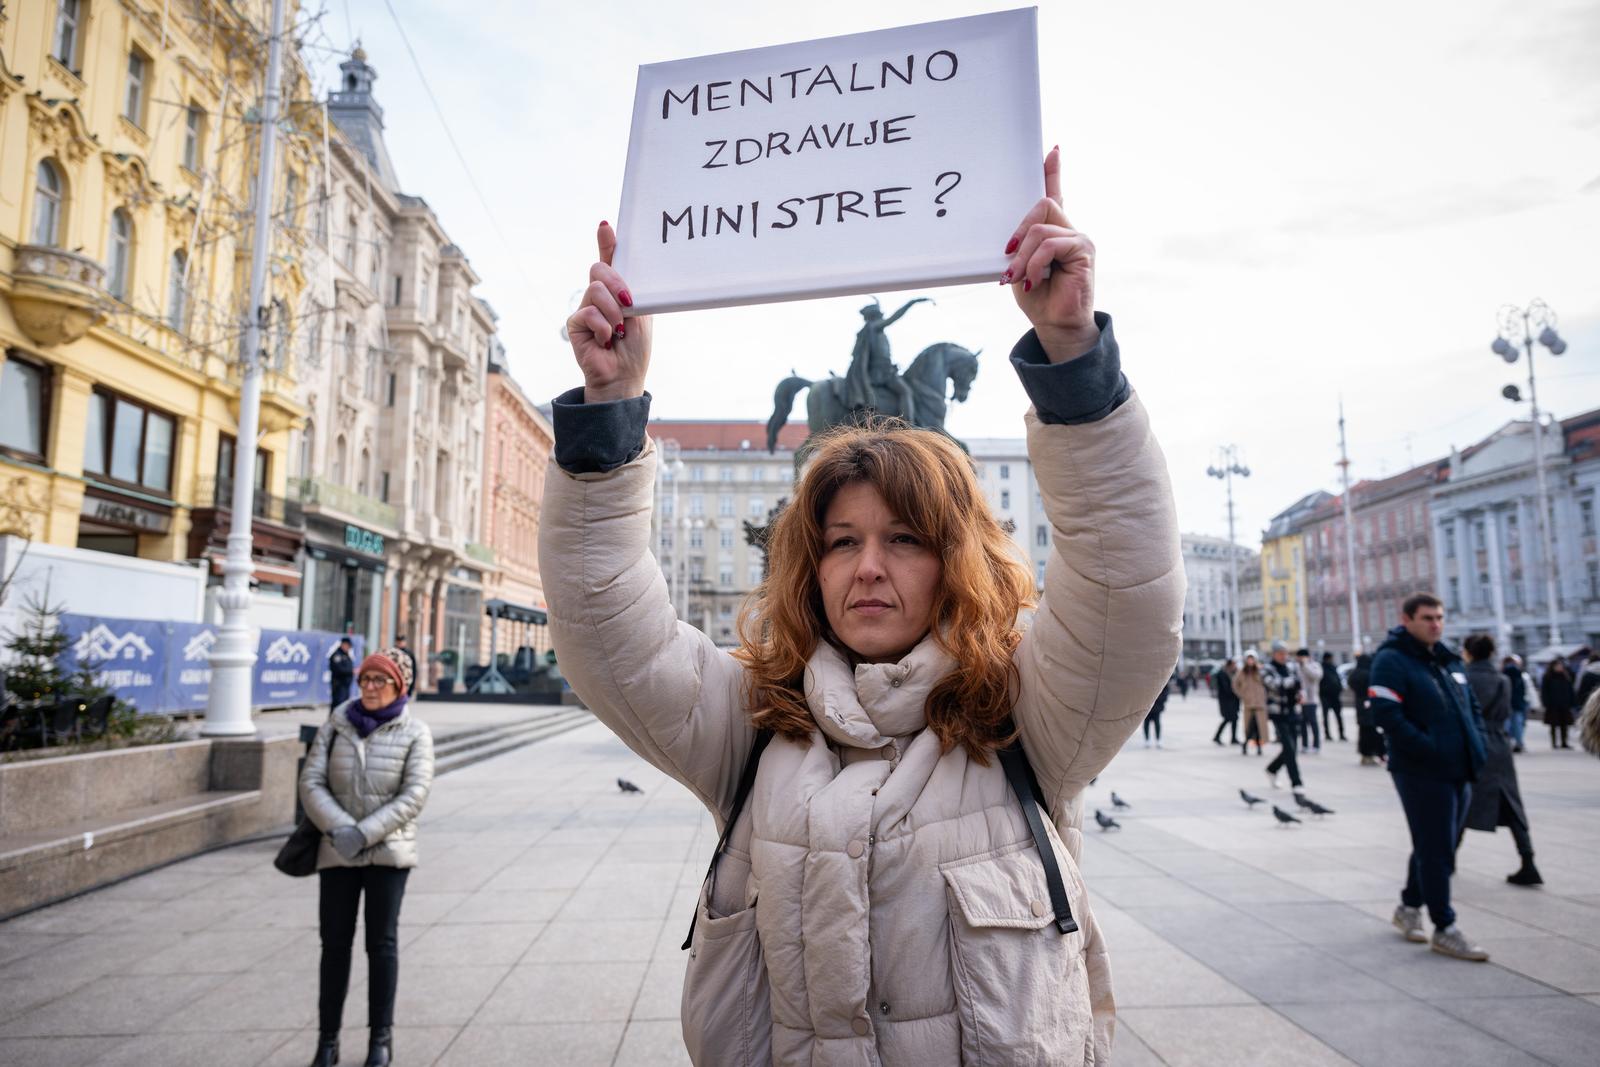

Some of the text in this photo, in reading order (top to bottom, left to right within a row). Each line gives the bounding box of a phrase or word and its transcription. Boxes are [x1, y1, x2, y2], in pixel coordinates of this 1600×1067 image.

[662, 49, 959, 120] MENTALNO
[702, 115, 916, 169] ZDRAVLJE
[662, 171, 962, 244] MINISTRE ?
